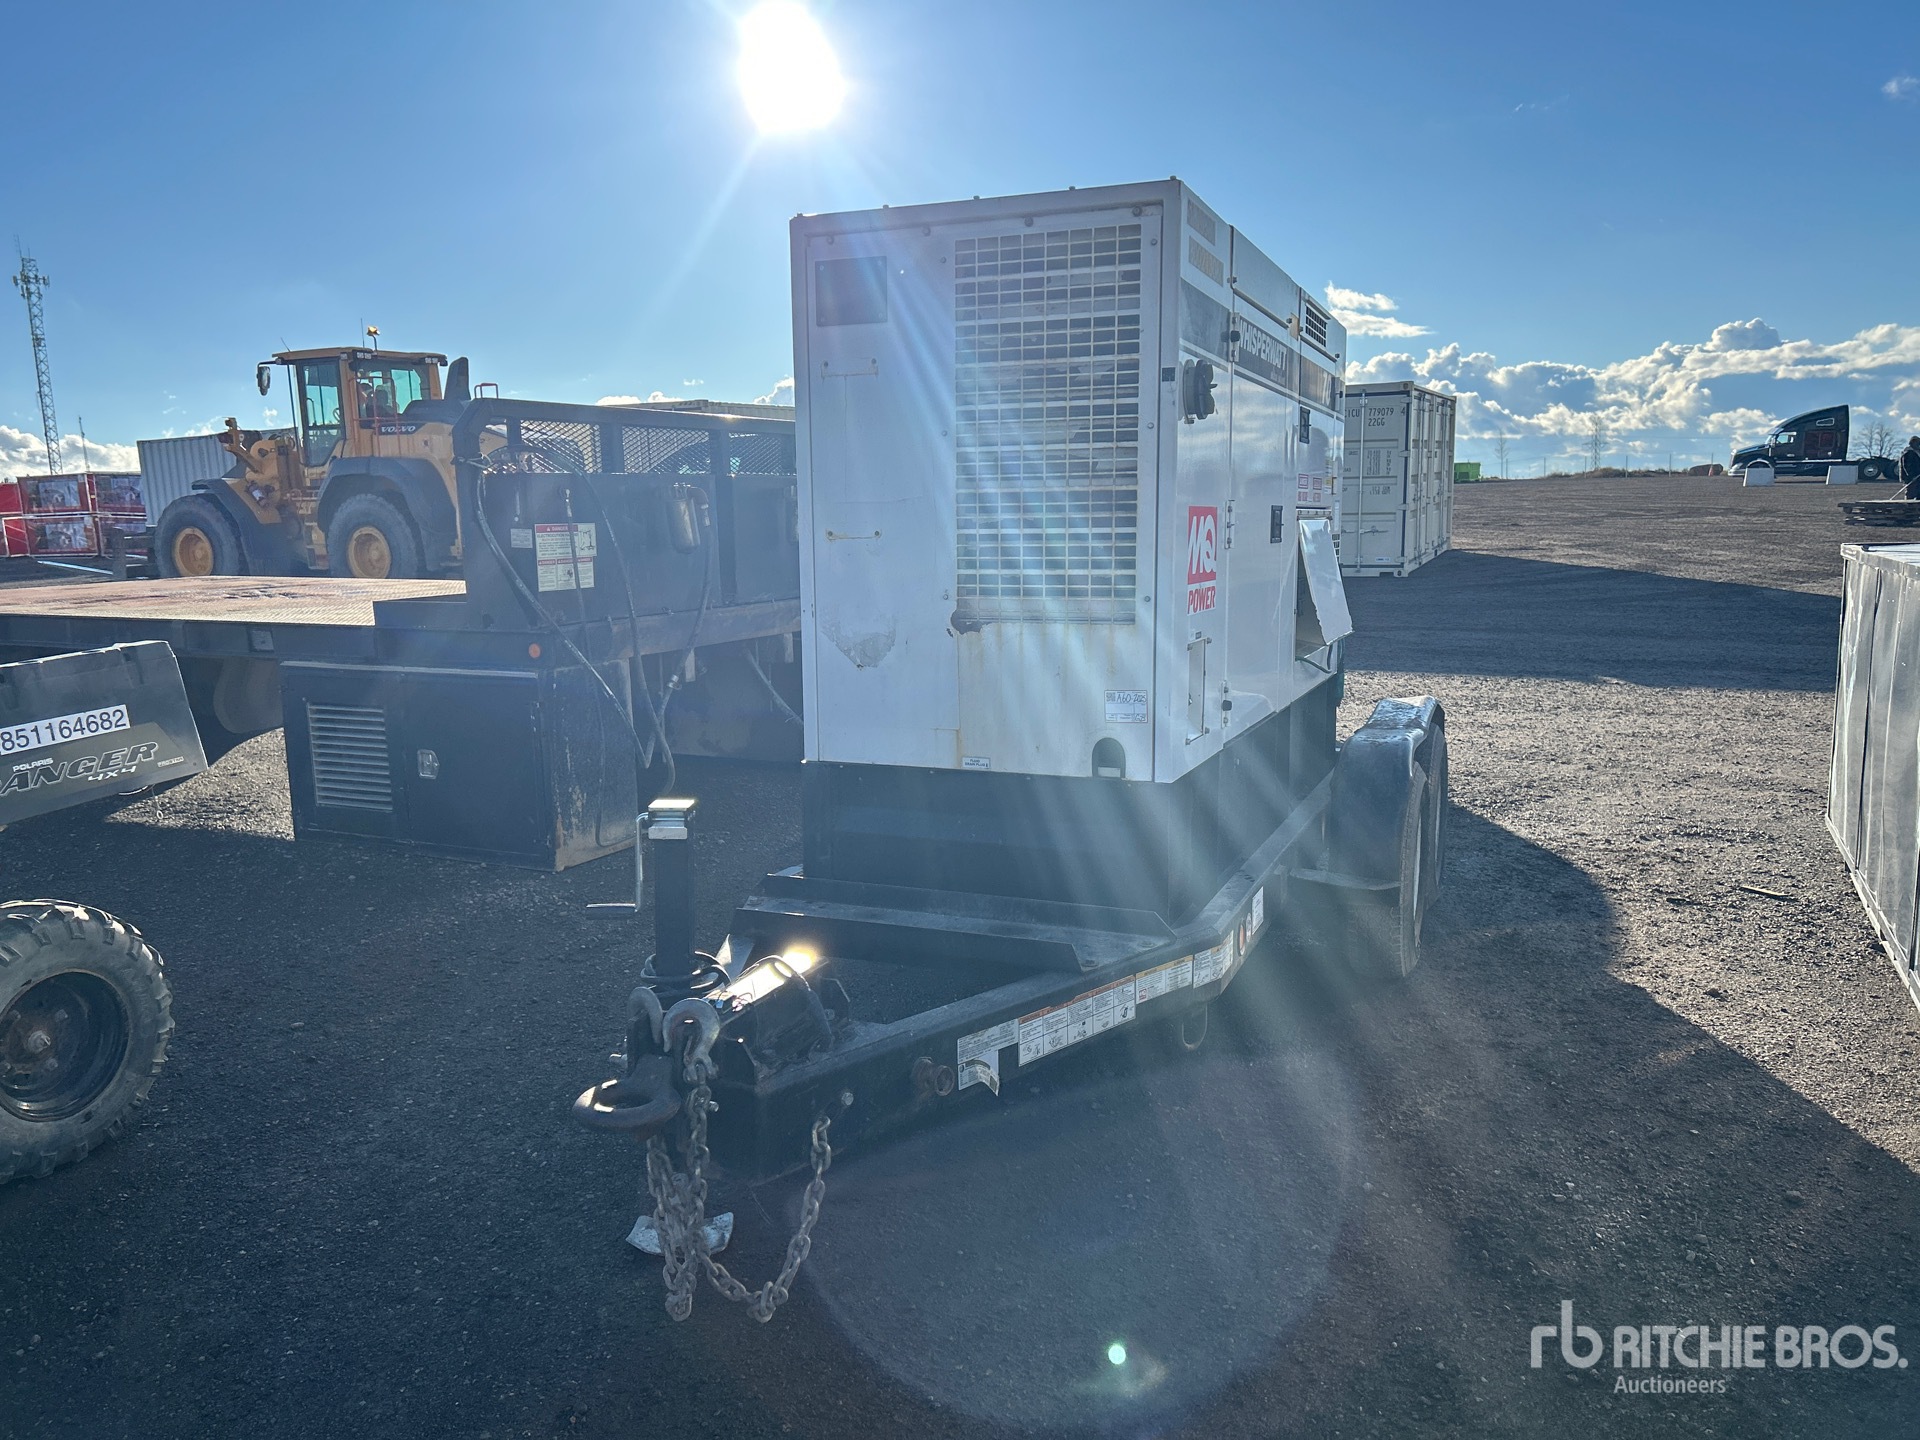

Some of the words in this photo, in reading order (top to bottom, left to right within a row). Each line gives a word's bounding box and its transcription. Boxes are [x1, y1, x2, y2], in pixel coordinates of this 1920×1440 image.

[1368, 418, 1386, 427] 22GG
[1369, 408, 1395, 416] 779079
[1187, 514, 1217, 574] MQ
[1187, 586, 1216, 614] POWER
[1, 709, 127, 751] 851164682
[0, 742, 159, 796] ANGER
[13, 757, 54, 772] POLARIS
